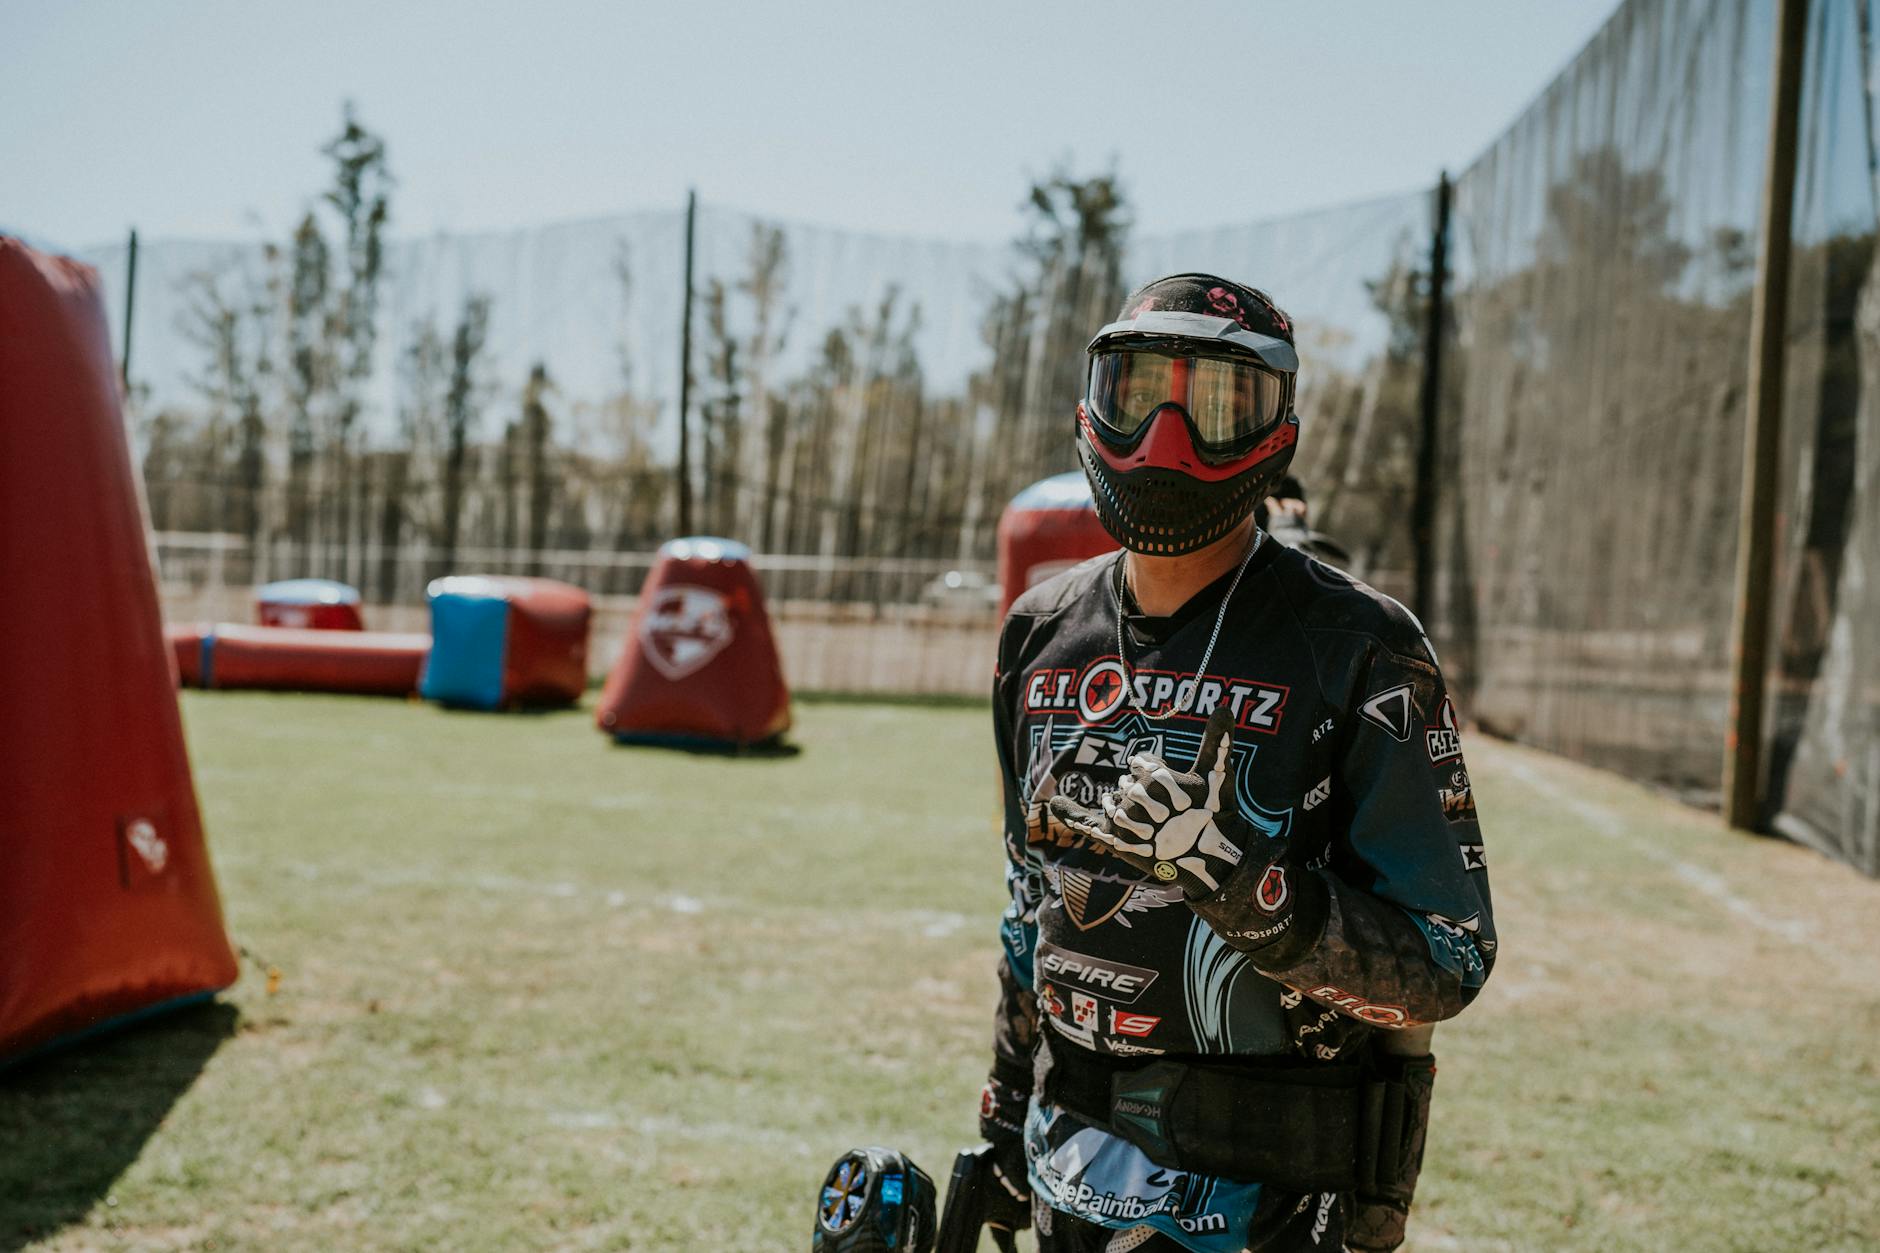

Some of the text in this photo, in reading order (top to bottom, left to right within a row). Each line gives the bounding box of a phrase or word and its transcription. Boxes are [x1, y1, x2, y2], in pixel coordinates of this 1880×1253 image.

[1127, 674, 1282, 728] SPORTZ
[1311, 717, 1335, 745] RTZ
[1043, 952, 1145, 995] SPIRE
